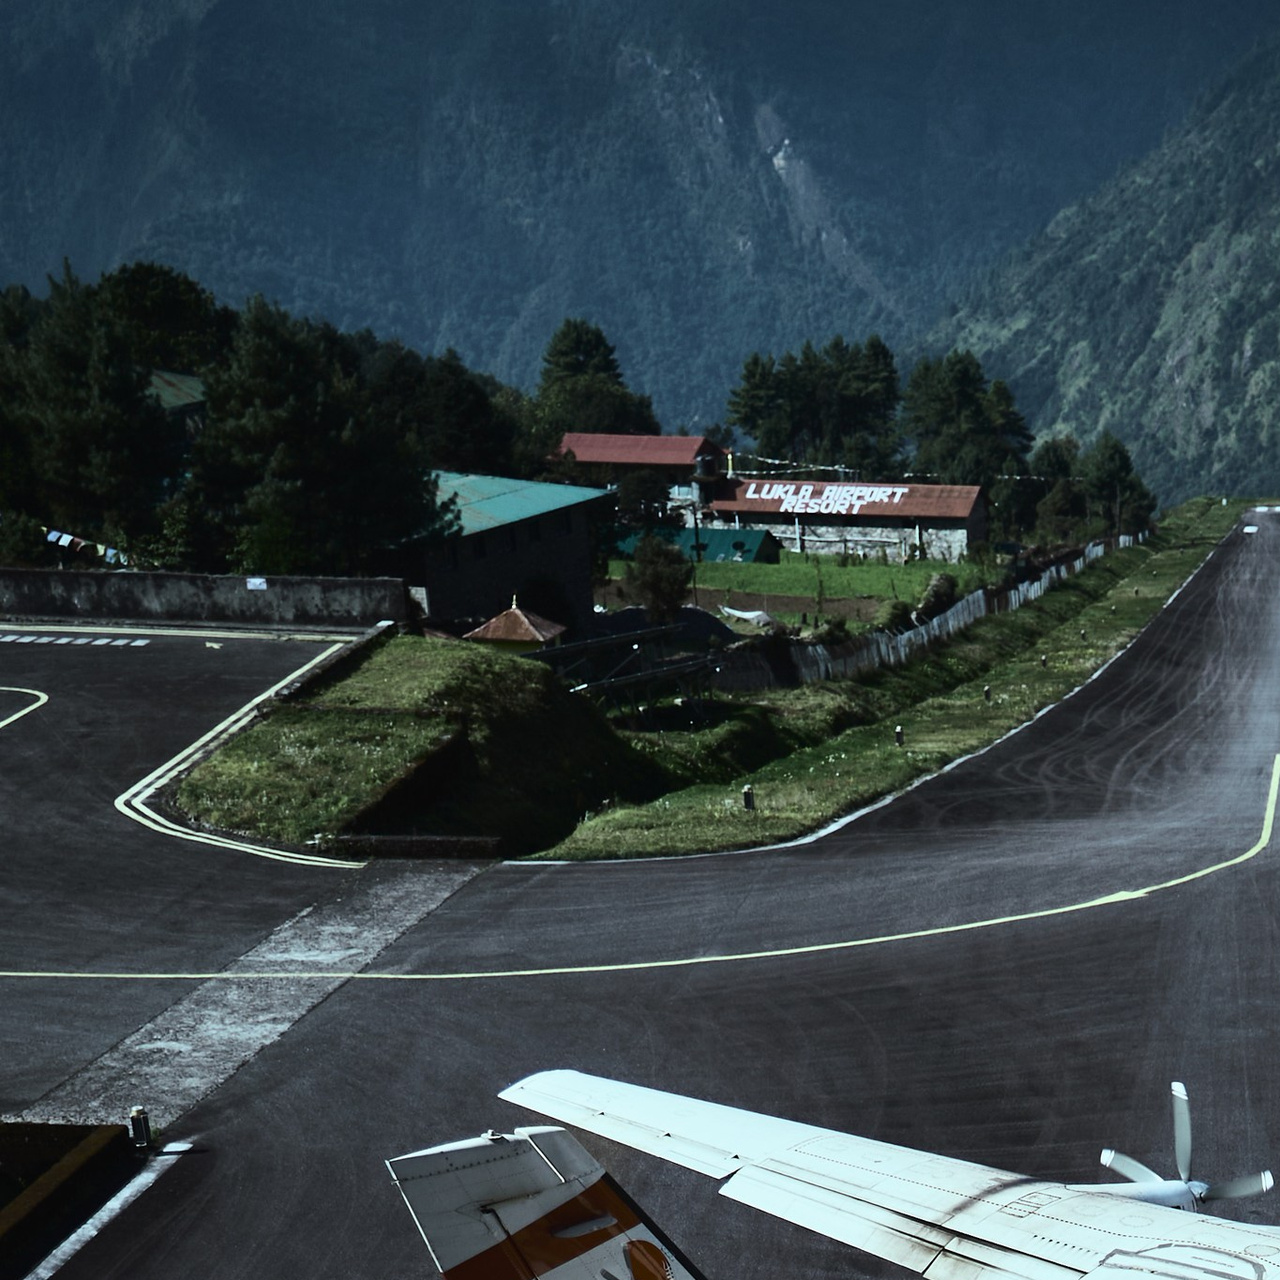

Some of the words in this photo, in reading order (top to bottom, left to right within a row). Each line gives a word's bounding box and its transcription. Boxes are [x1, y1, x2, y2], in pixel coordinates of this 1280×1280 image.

[745, 483, 814, 500] LUKLA
[821, 485, 909, 503] AIRPORT
[779, 498, 867, 514] RESORT
